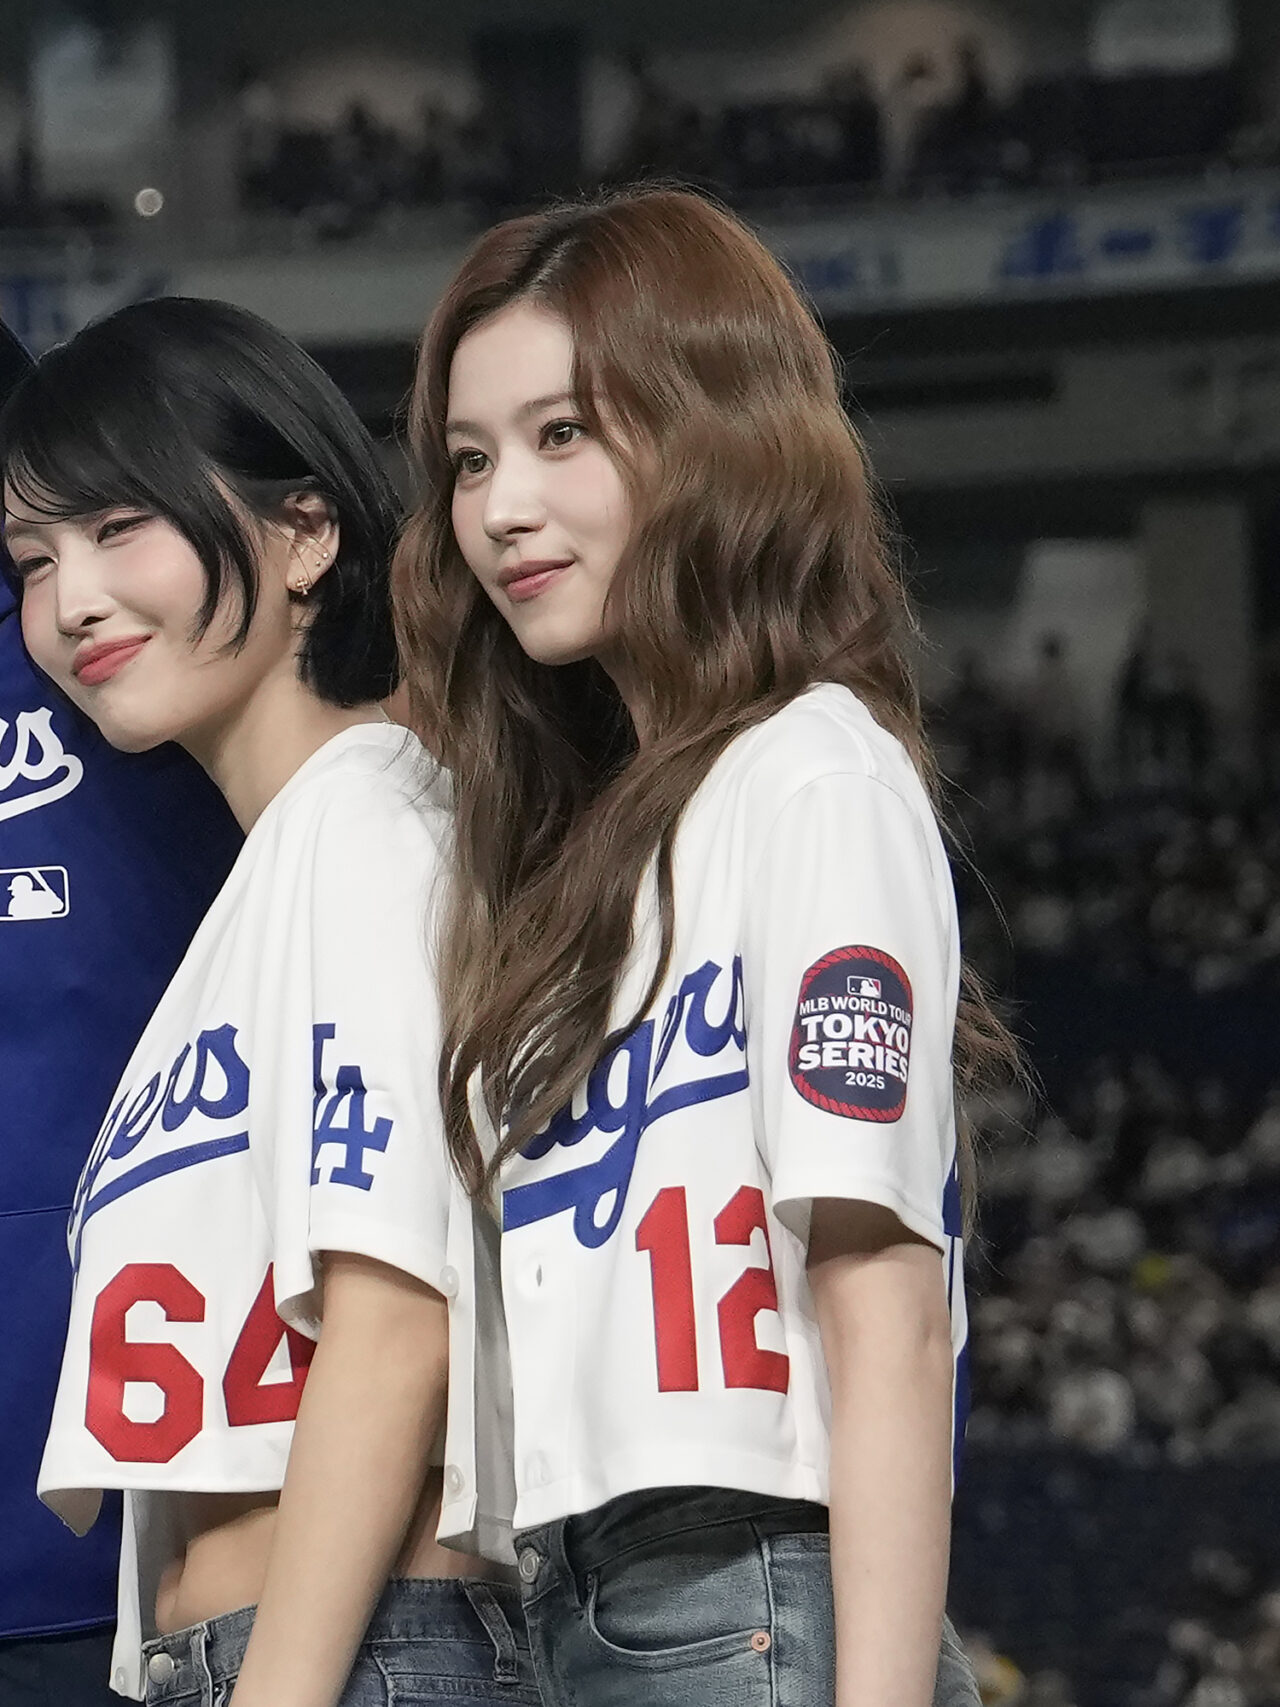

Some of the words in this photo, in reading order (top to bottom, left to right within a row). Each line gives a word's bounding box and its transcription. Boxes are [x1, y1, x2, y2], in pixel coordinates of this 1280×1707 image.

[799, 998, 829, 1016] MLB
[831, 997, 888, 1015] WORLD
[801, 1013, 909, 1054] TOKYO
[798, 1042, 908, 1083] SERIES
[845, 1071, 886, 1090] 2025
[310, 1023, 394, 1191] LA
[634, 1184, 790, 1396] 12
[84, 1262, 318, 1464] 64
